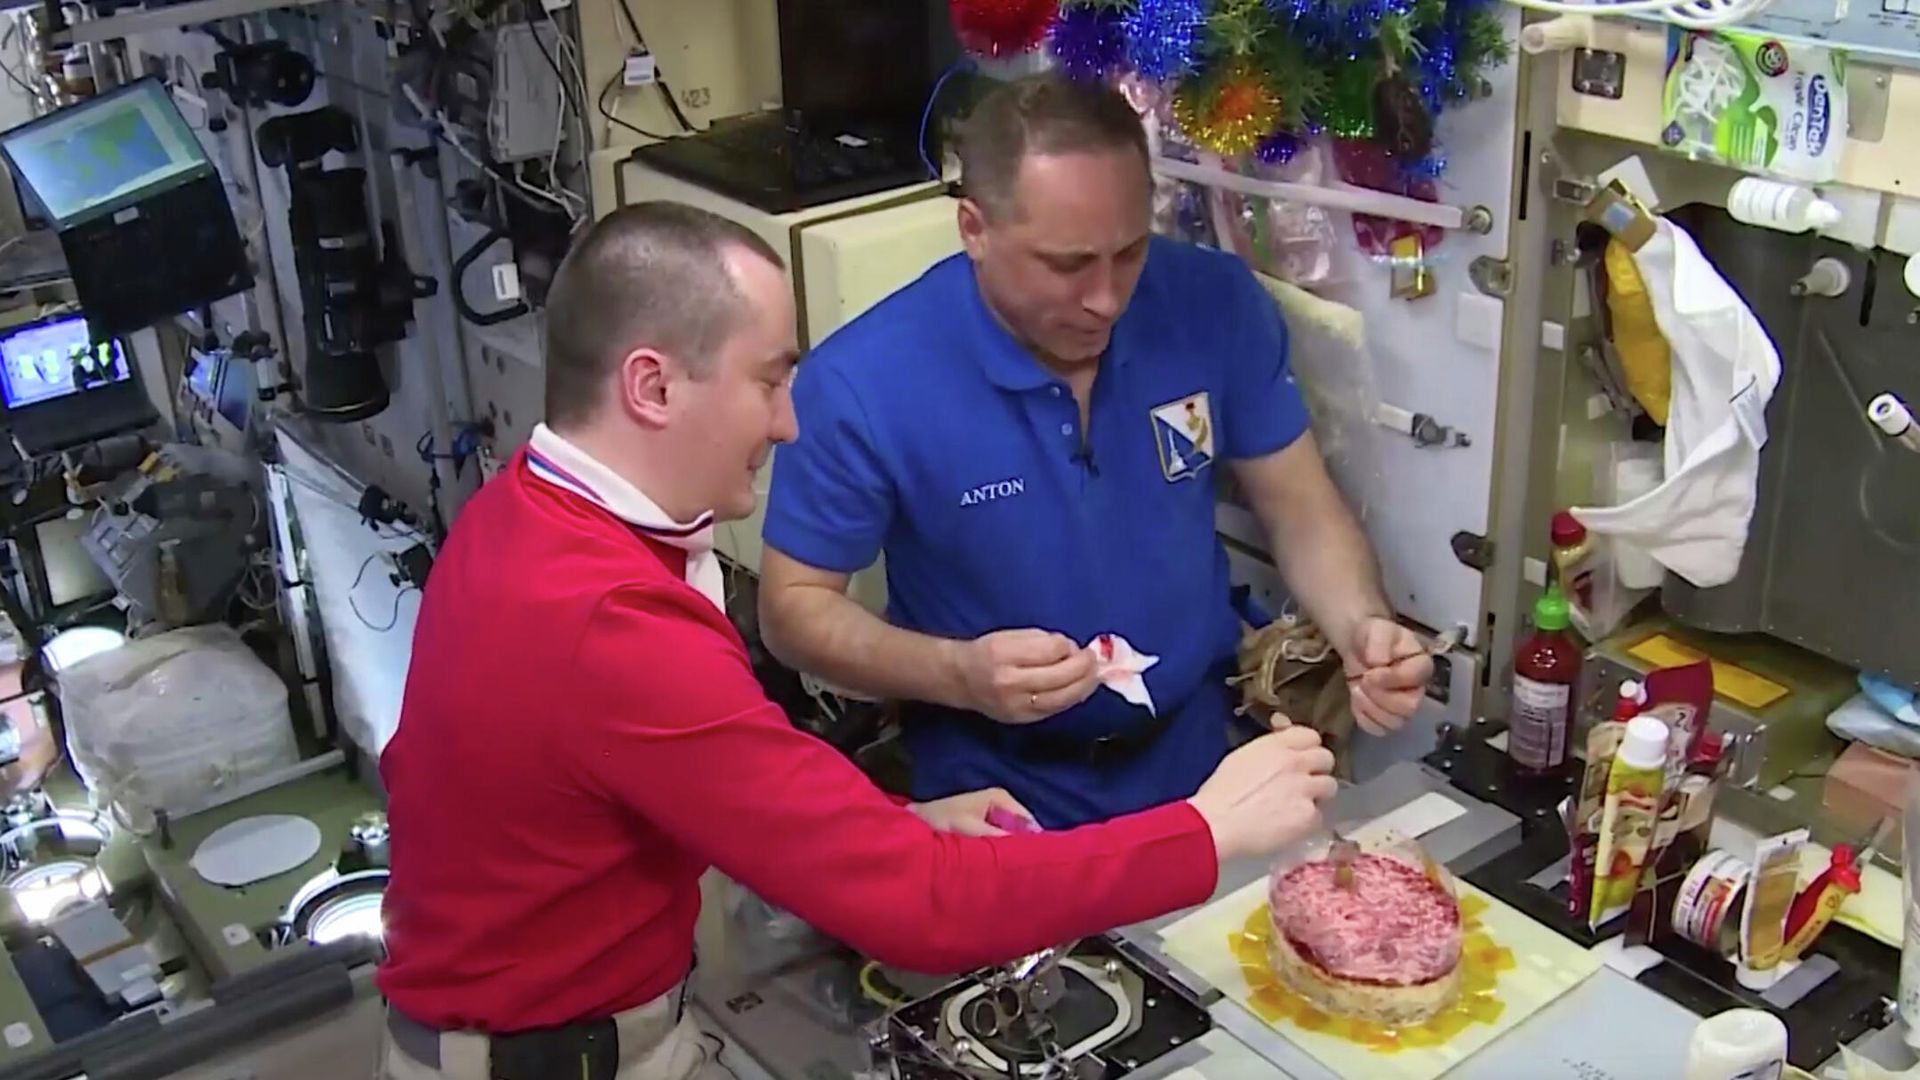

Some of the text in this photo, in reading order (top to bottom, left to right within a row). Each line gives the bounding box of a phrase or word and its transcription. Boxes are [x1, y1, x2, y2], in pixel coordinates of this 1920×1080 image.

[1788, 111, 1804, 151] Clean
[1806, 77, 1829, 156] DenTek
[959, 477, 1025, 507] ANTON
